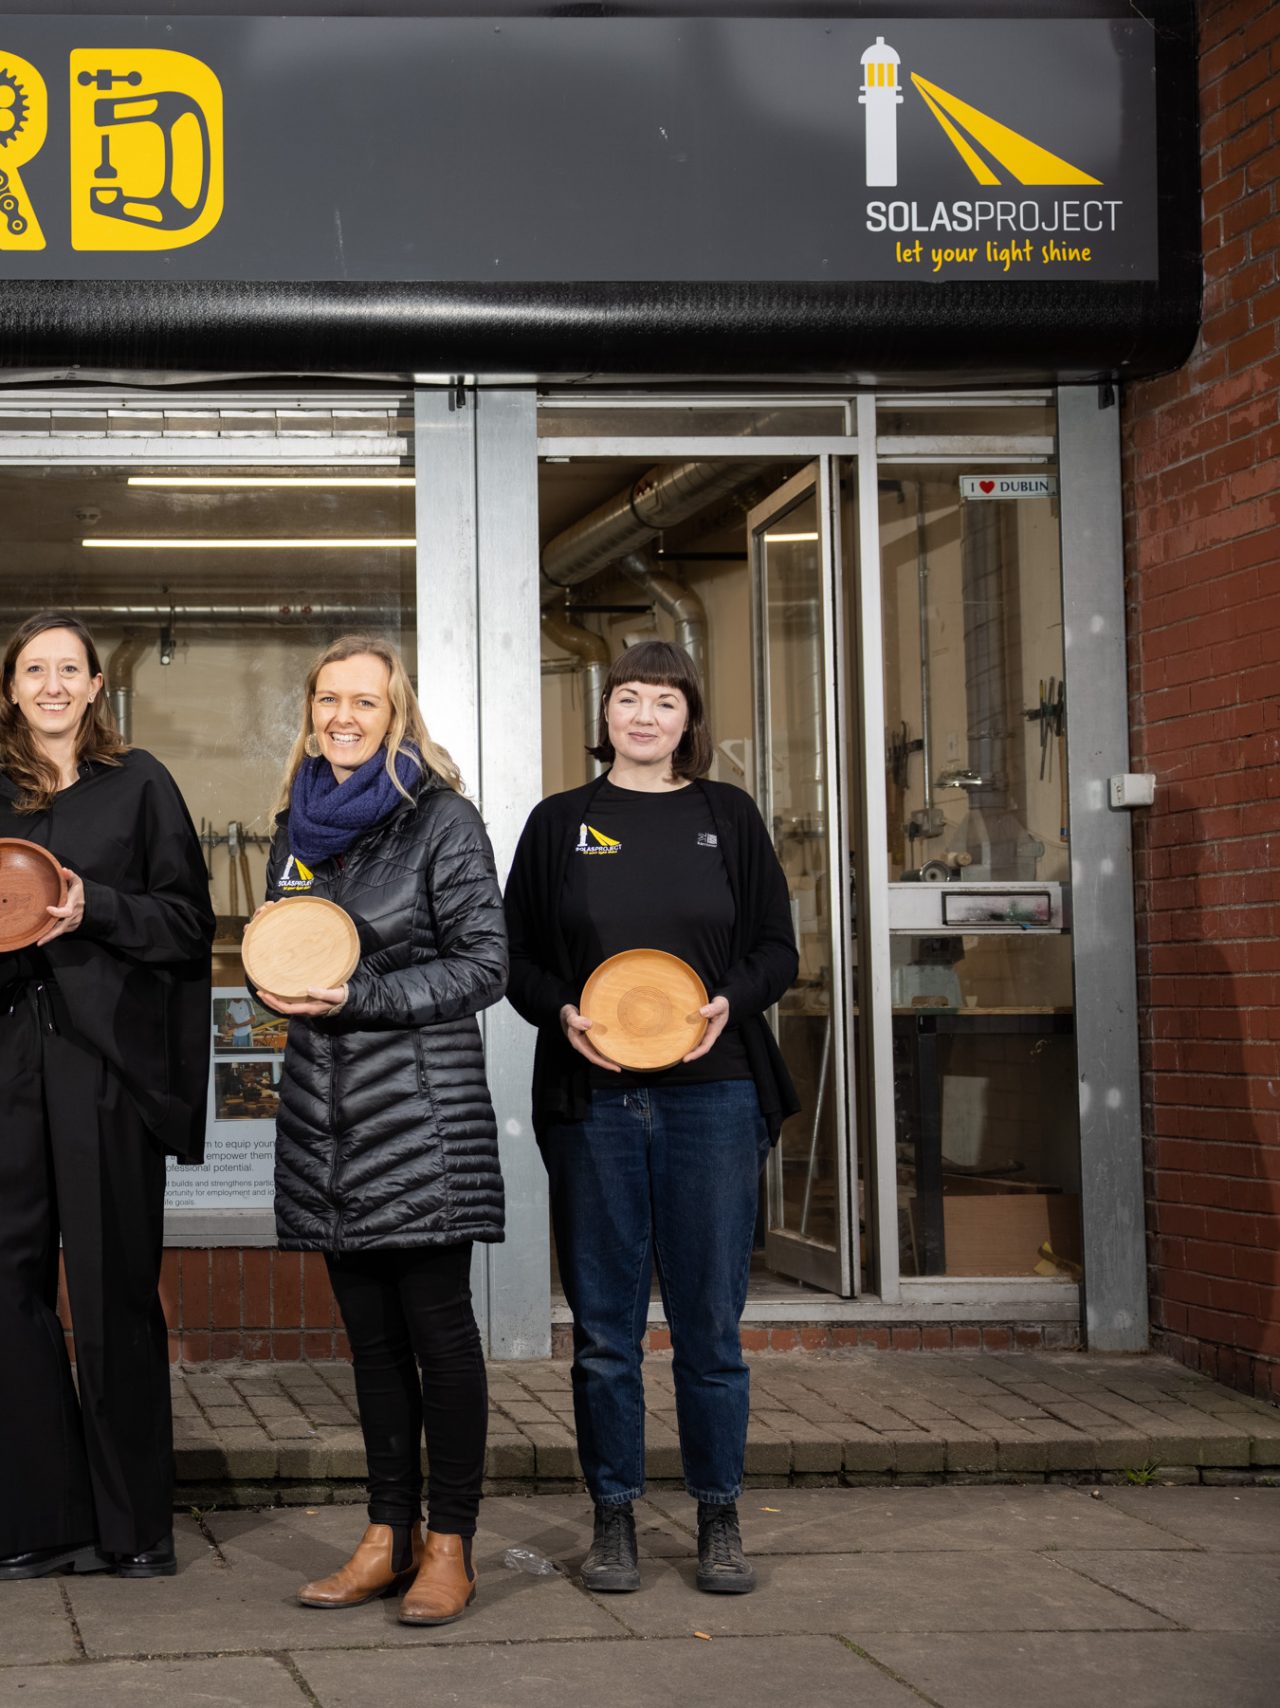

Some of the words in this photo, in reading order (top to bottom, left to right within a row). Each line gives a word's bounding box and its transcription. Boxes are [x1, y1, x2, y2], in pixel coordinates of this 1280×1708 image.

[866, 201, 1122, 232] SOLASPROJECT
[896, 240, 923, 262] let
[932, 248, 977, 272] your
[987, 240, 1033, 271] light
[1042, 240, 1091, 263] shine
[971, 482, 975, 492] I
[1000, 481, 1049, 492] DUBLIN
[225, 1140, 251, 1149] equip
[206, 1153, 248, 1161] empower
[250, 1152, 273, 1160] them
[211, 1180, 252, 1188] strengthens
[207, 1190, 250, 1198] employment
